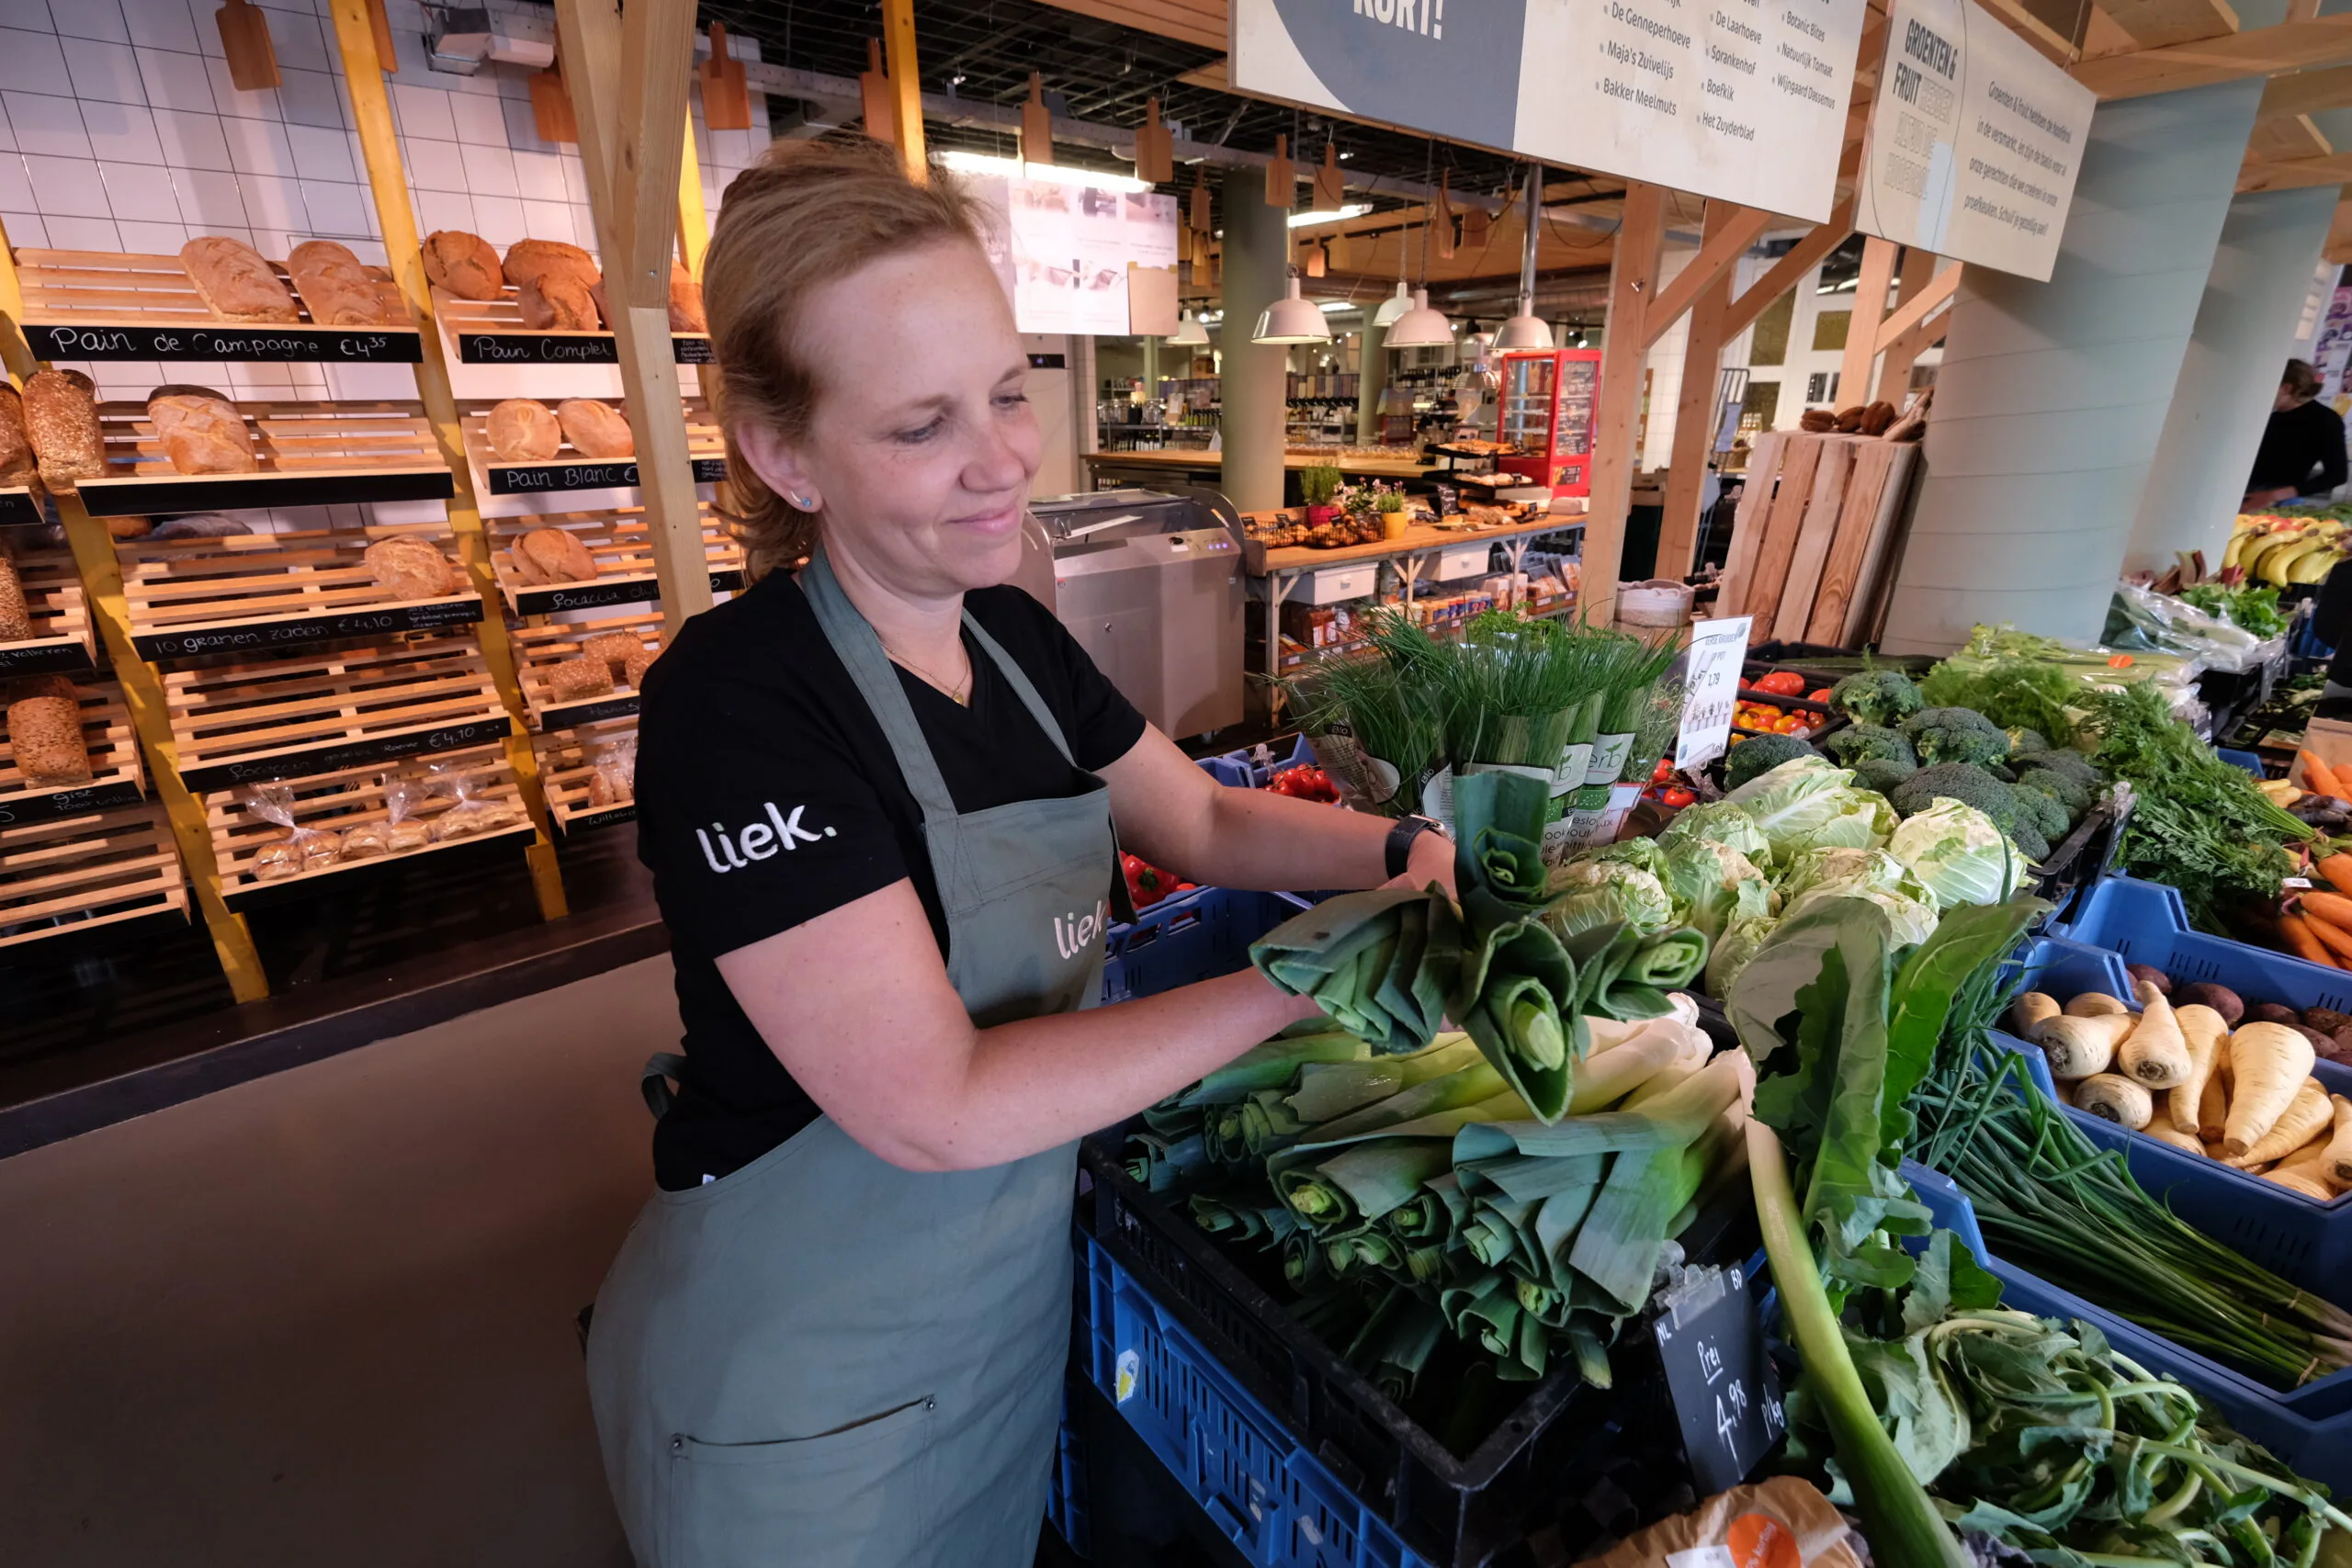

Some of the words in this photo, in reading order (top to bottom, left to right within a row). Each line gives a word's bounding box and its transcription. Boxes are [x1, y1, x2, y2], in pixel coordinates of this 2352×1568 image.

[1611, 1, 1624, 21] De
[1625, 7, 1690, 49] Genneperhoeve
[1715, 10, 1726, 28] De
[1726, 16, 1762, 44] Laarhoeve
[1786, 11, 1810, 33] Botanic
[1810, 23, 1826, 42] Bites
[1607, 39, 1637, 65] Maja's
[1637, 51, 1674, 80] Zuivelijs
[1711, 45, 1757, 75] Sprankenhof
[1781, 42, 1813, 70] Natuurlijk
[1813, 57, 1834, 77] Tomaat
[1904, 18, 1953, 76] GROENTEN
[1949, 48, 1959, 80] &
[1603, 77, 1634, 101] Bakker
[1635, 89, 1677, 115] Meelmuts
[1777, 73, 1808, 97] Wijngaard
[1807, 87, 1836, 109] Dassemus
[1893, 62, 1923, 106] FRUIT
[1702, 112, 1715, 129] Het
[1716, 116, 1755, 141] Zuyderblad
[50, 326, 137, 354] Pain
[153, 333, 182, 351] de
[191, 333, 320, 358] Campagne
[473, 335, 530, 359] Pain
[507, 468, 553, 488] Pain
[564, 467, 617, 486] Blanc
[154, 640, 177, 654] 10
[183, 631, 261, 653] granen
[268, 624, 329, 641] zaden
[52, 789, 95, 805] gist
[695, 802, 837, 874] liek.
[1657, 1322, 1672, 1348] NL
[1697, 1335, 1722, 1379] Prei
[1761, 1382, 1785, 1440] p/kg
[1716, 1379, 1747, 1481] 4,98
